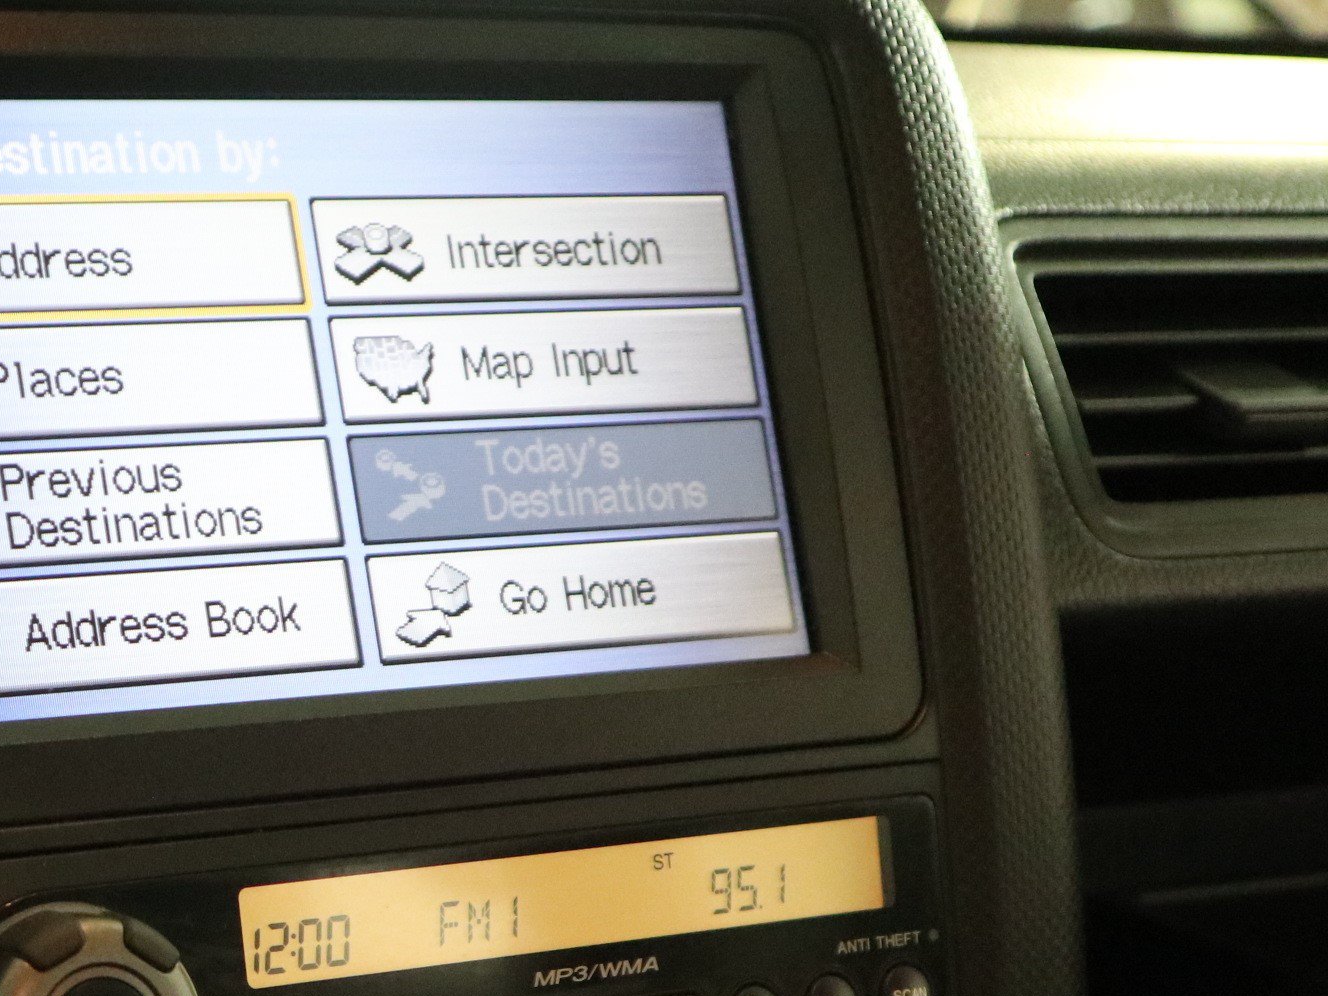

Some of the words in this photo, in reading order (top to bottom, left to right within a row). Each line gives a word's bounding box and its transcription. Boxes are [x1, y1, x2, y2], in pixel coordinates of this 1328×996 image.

[218, 131, 279, 182] by:
[446, 231, 662, 270] Intersection
[461, 344, 534, 386] Map
[552, 341, 638, 384] Input
[476, 437, 620, 477] Today's
[482, 475, 707, 521] Destinations
[5, 503, 264, 549] Destinations
[500, 580, 548, 615] Go
[562, 574, 656, 611] Home
[25, 604, 189, 652] Address
[206, 596, 302, 637] Book
[652, 852, 674, 872] ST
[710, 864, 787, 915] 95.1
[253, 915, 351, 976] 12:00
[836, 938, 870, 955] ANTI
[875, 930, 921, 949] THEFT
[533, 956, 660, 989] MP3/WMA
